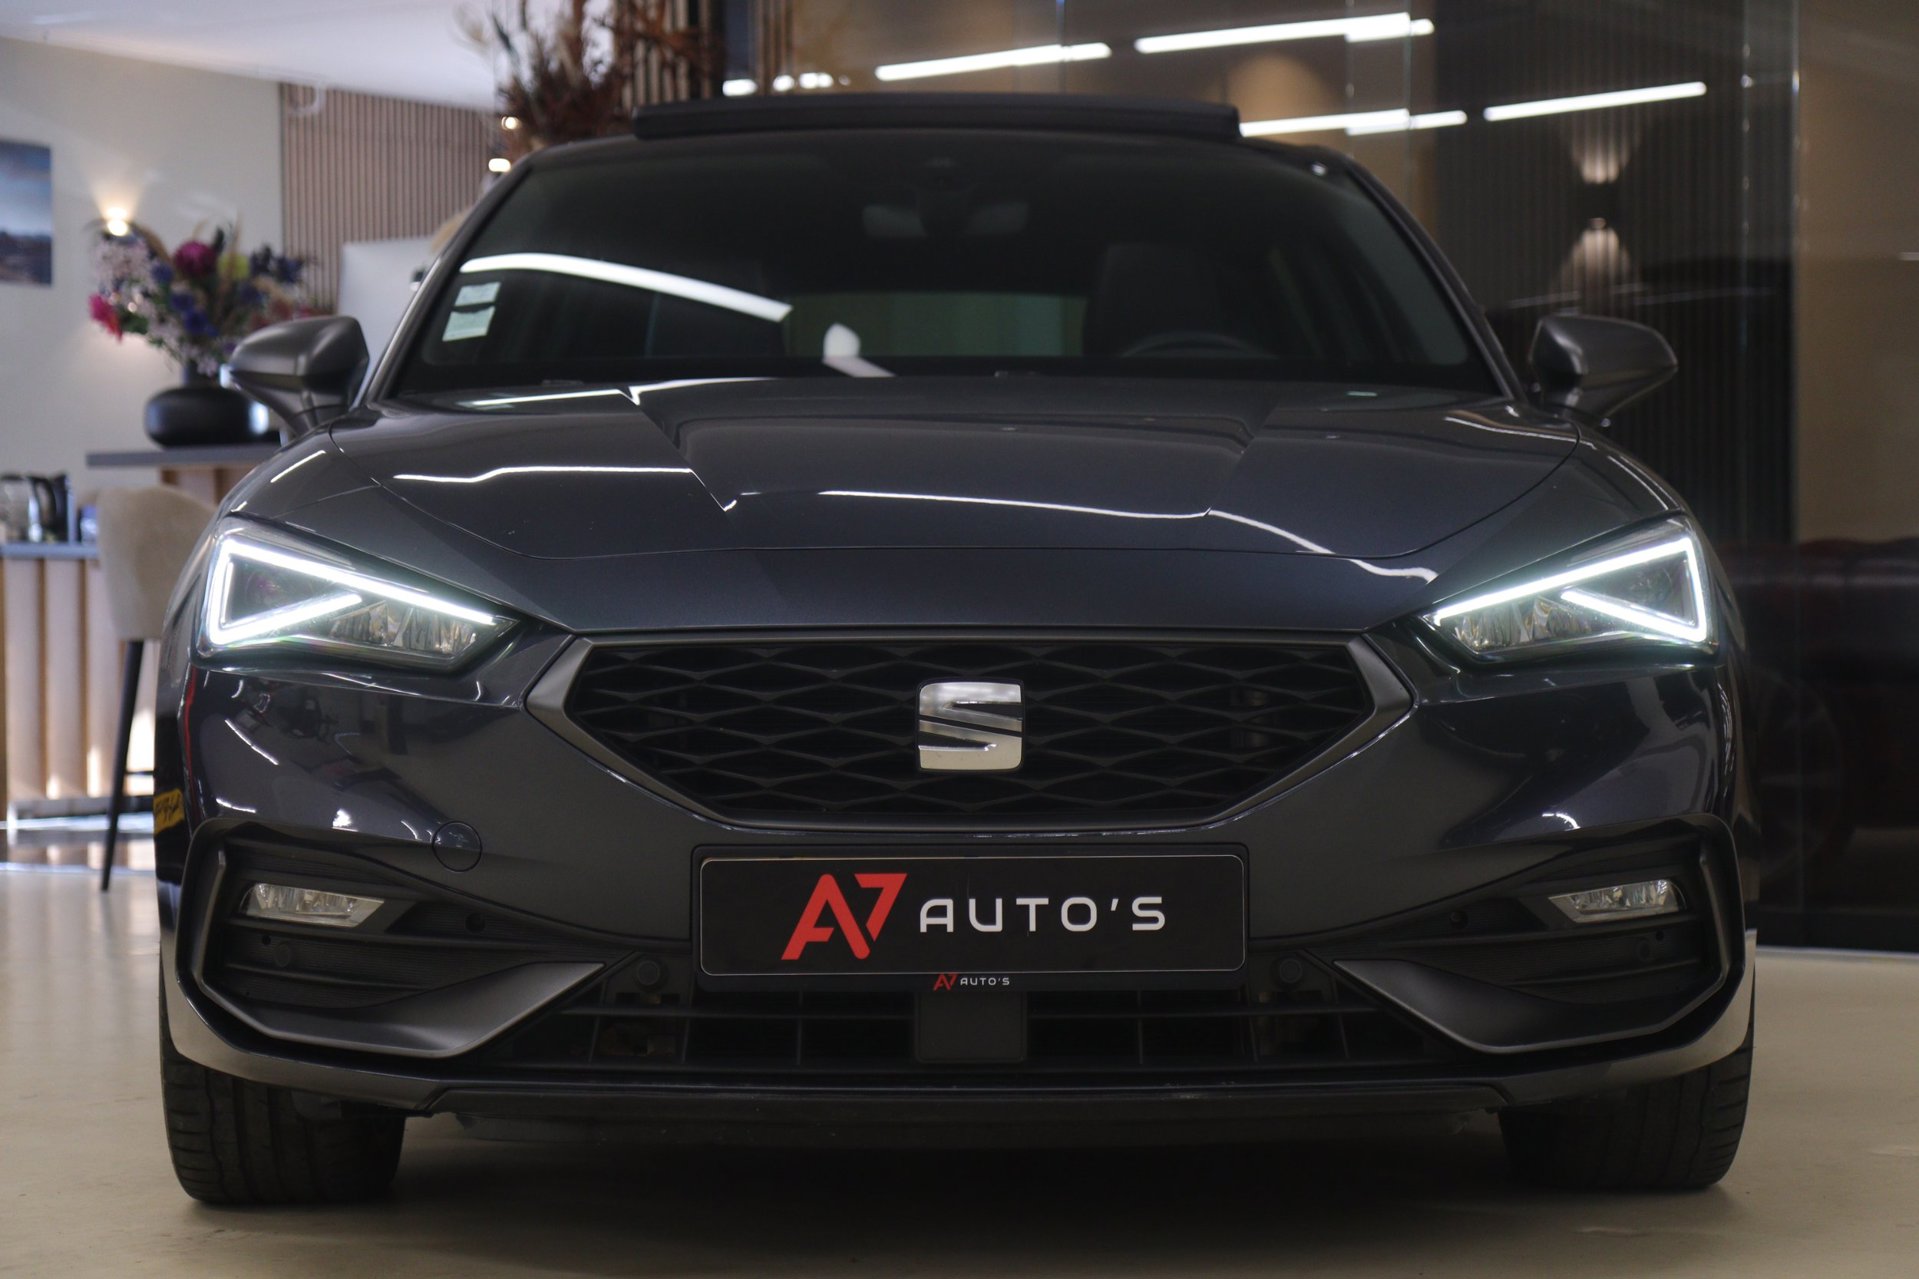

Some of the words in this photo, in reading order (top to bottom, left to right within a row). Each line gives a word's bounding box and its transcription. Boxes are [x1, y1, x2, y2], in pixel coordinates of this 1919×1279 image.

[781, 873, 907, 960] A7
[920, 897, 1166, 932] AUTO'S
[933, 972, 958, 991] A7
[960, 977, 1010, 986] AUTO'S
